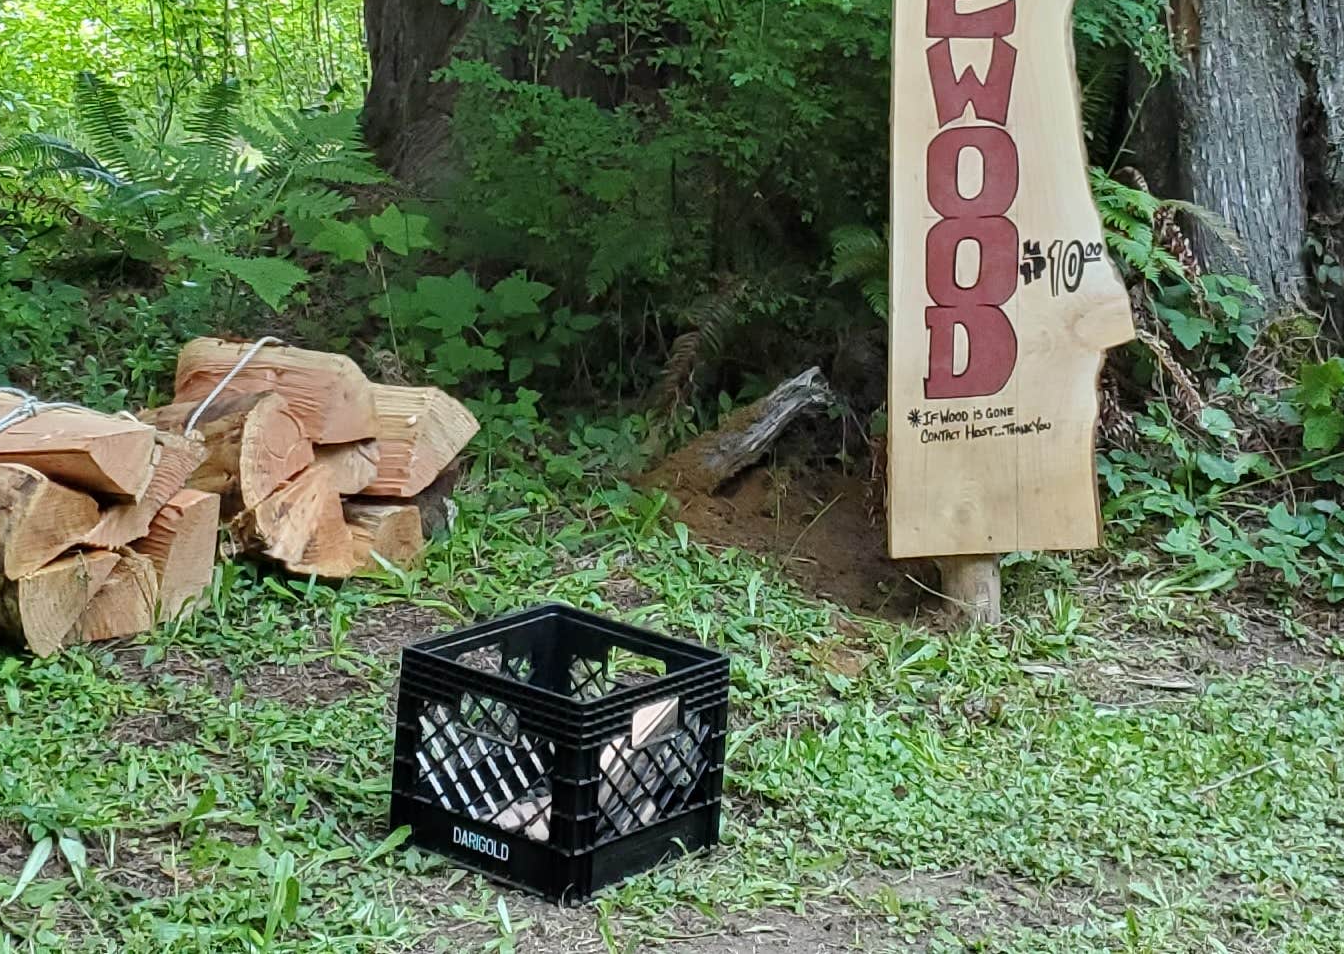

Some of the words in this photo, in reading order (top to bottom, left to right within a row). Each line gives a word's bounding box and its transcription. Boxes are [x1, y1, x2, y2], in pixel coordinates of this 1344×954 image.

[939, 408, 969, 425] WOOD
[985, 406, 1015, 419] GONE
[920, 428, 961, 444] CONTACT
[453, 826, 509, 861] DARIGOLD
